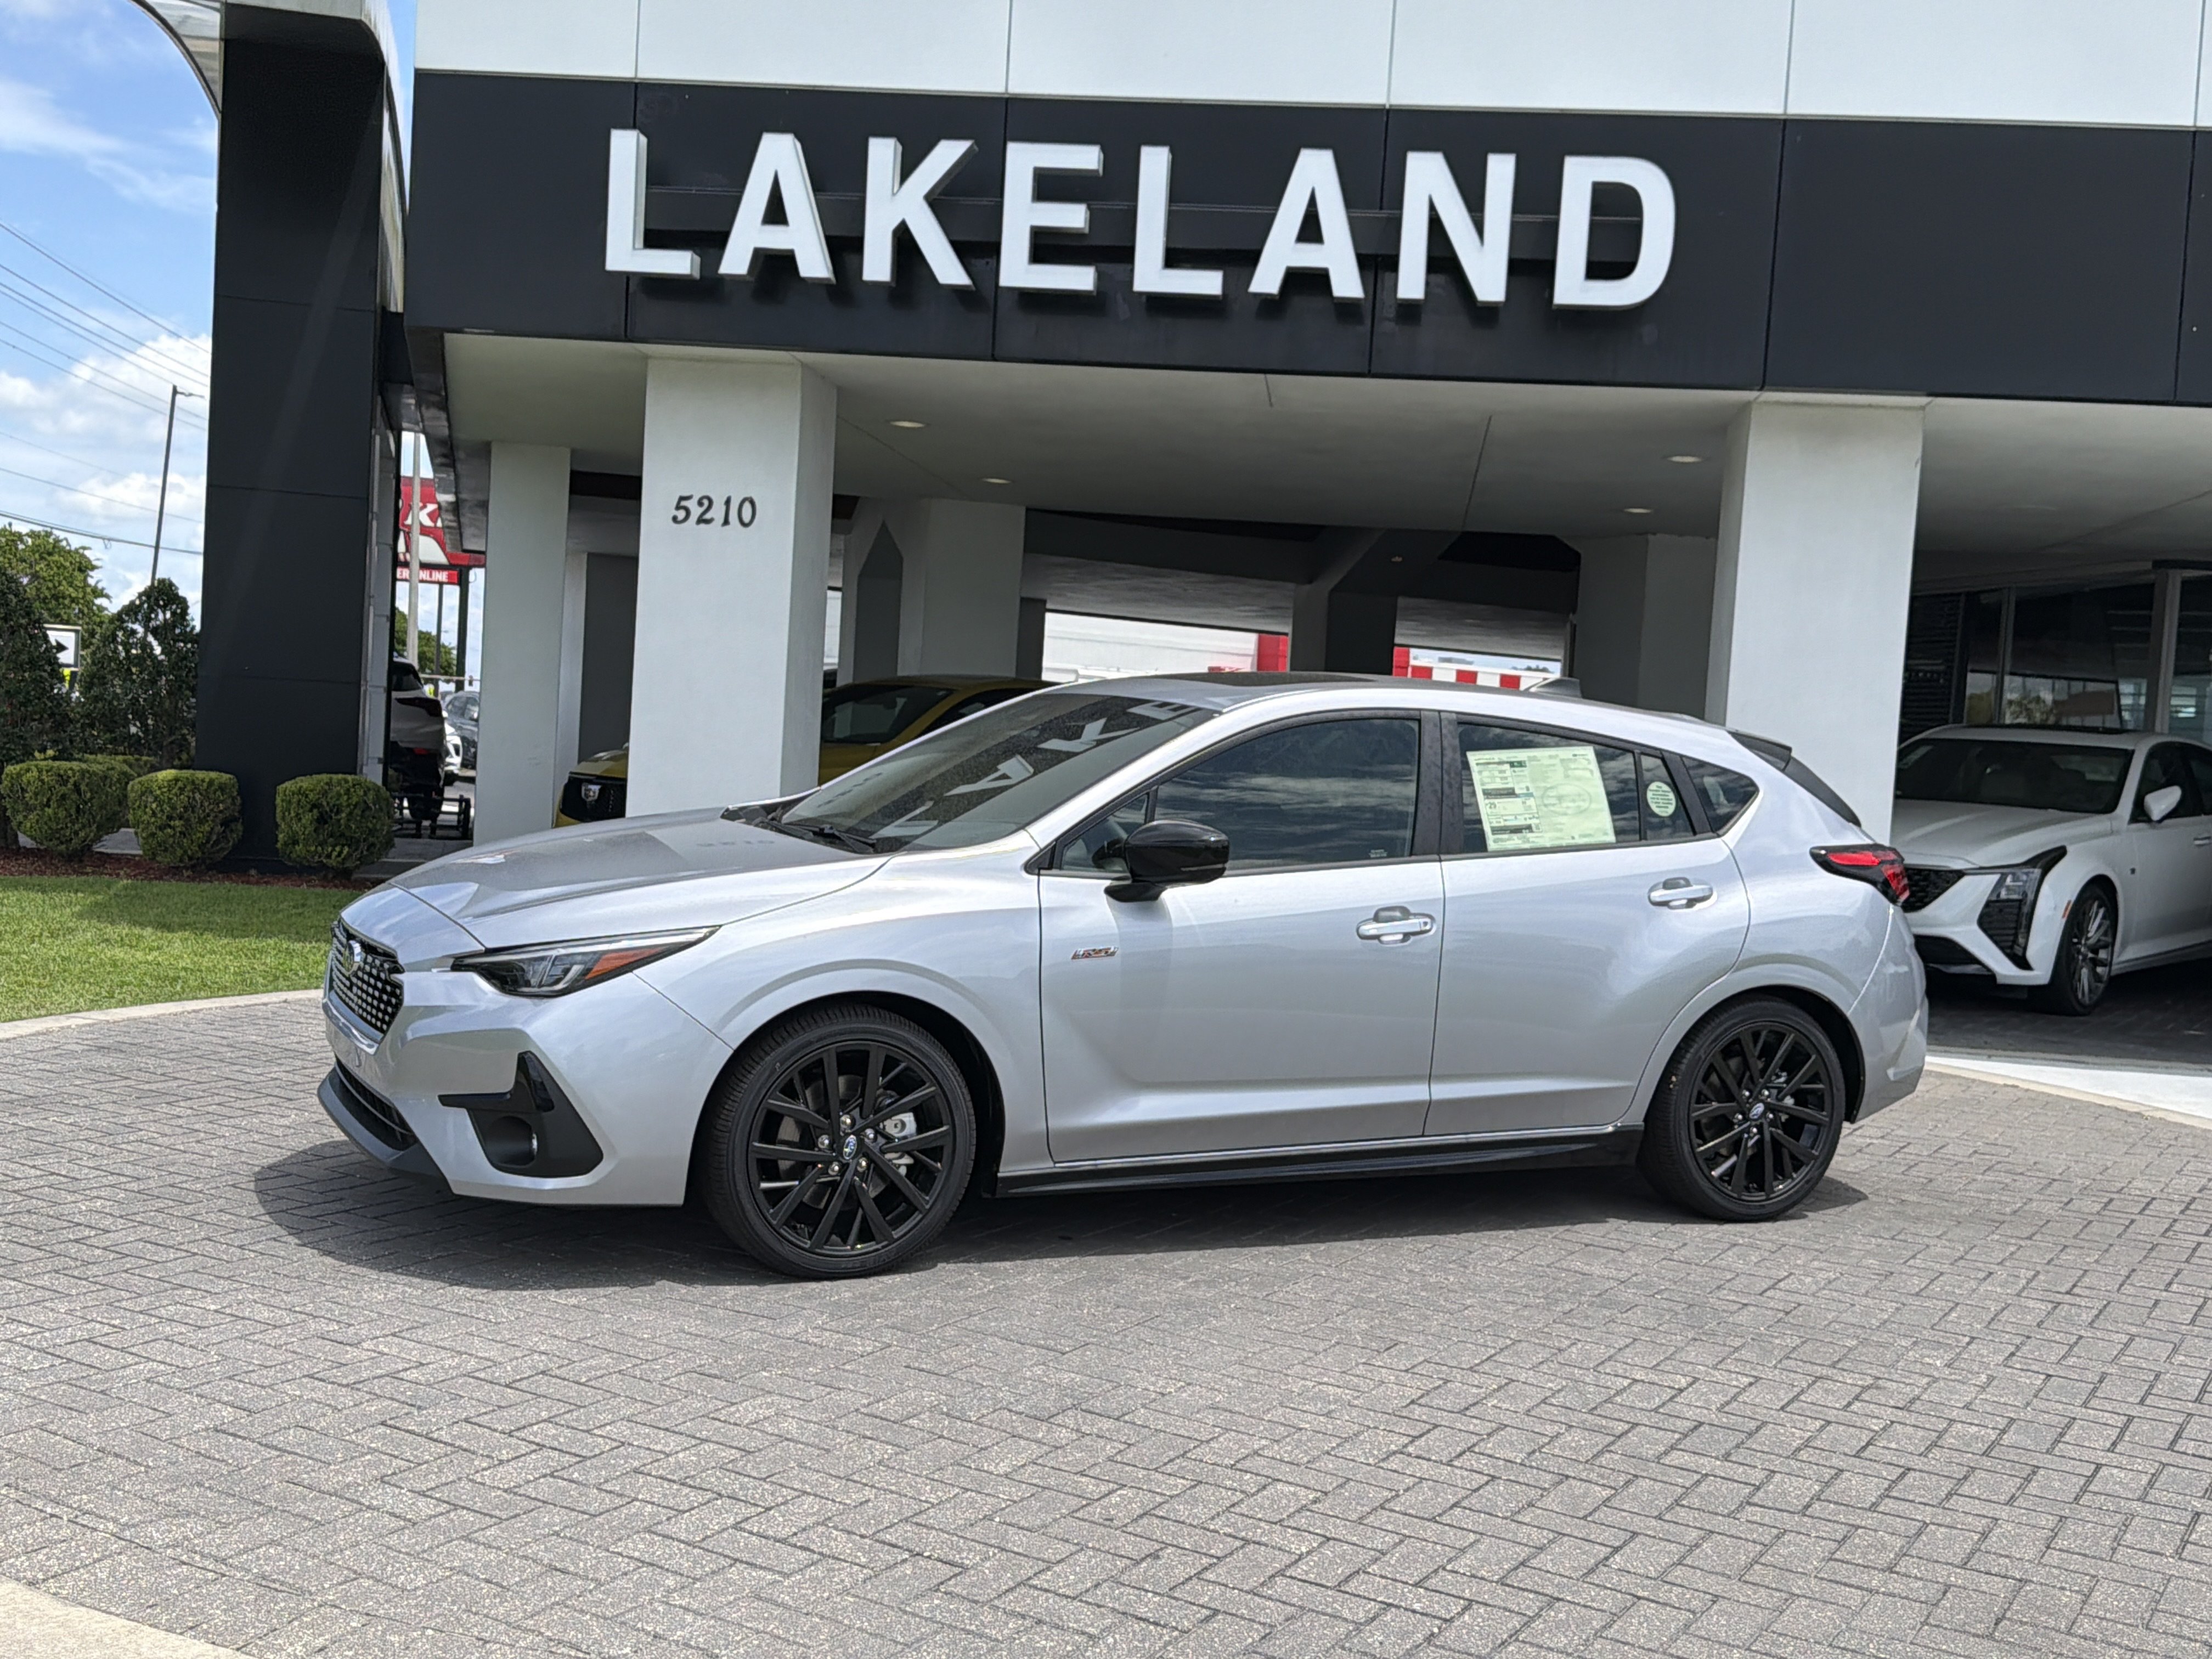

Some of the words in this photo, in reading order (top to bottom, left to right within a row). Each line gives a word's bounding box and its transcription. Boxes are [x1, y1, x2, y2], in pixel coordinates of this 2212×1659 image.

[605, 128, 1675, 308] LAKELAND
[672, 494, 757, 528] 5210
[419, 568, 449, 582] NLINE
